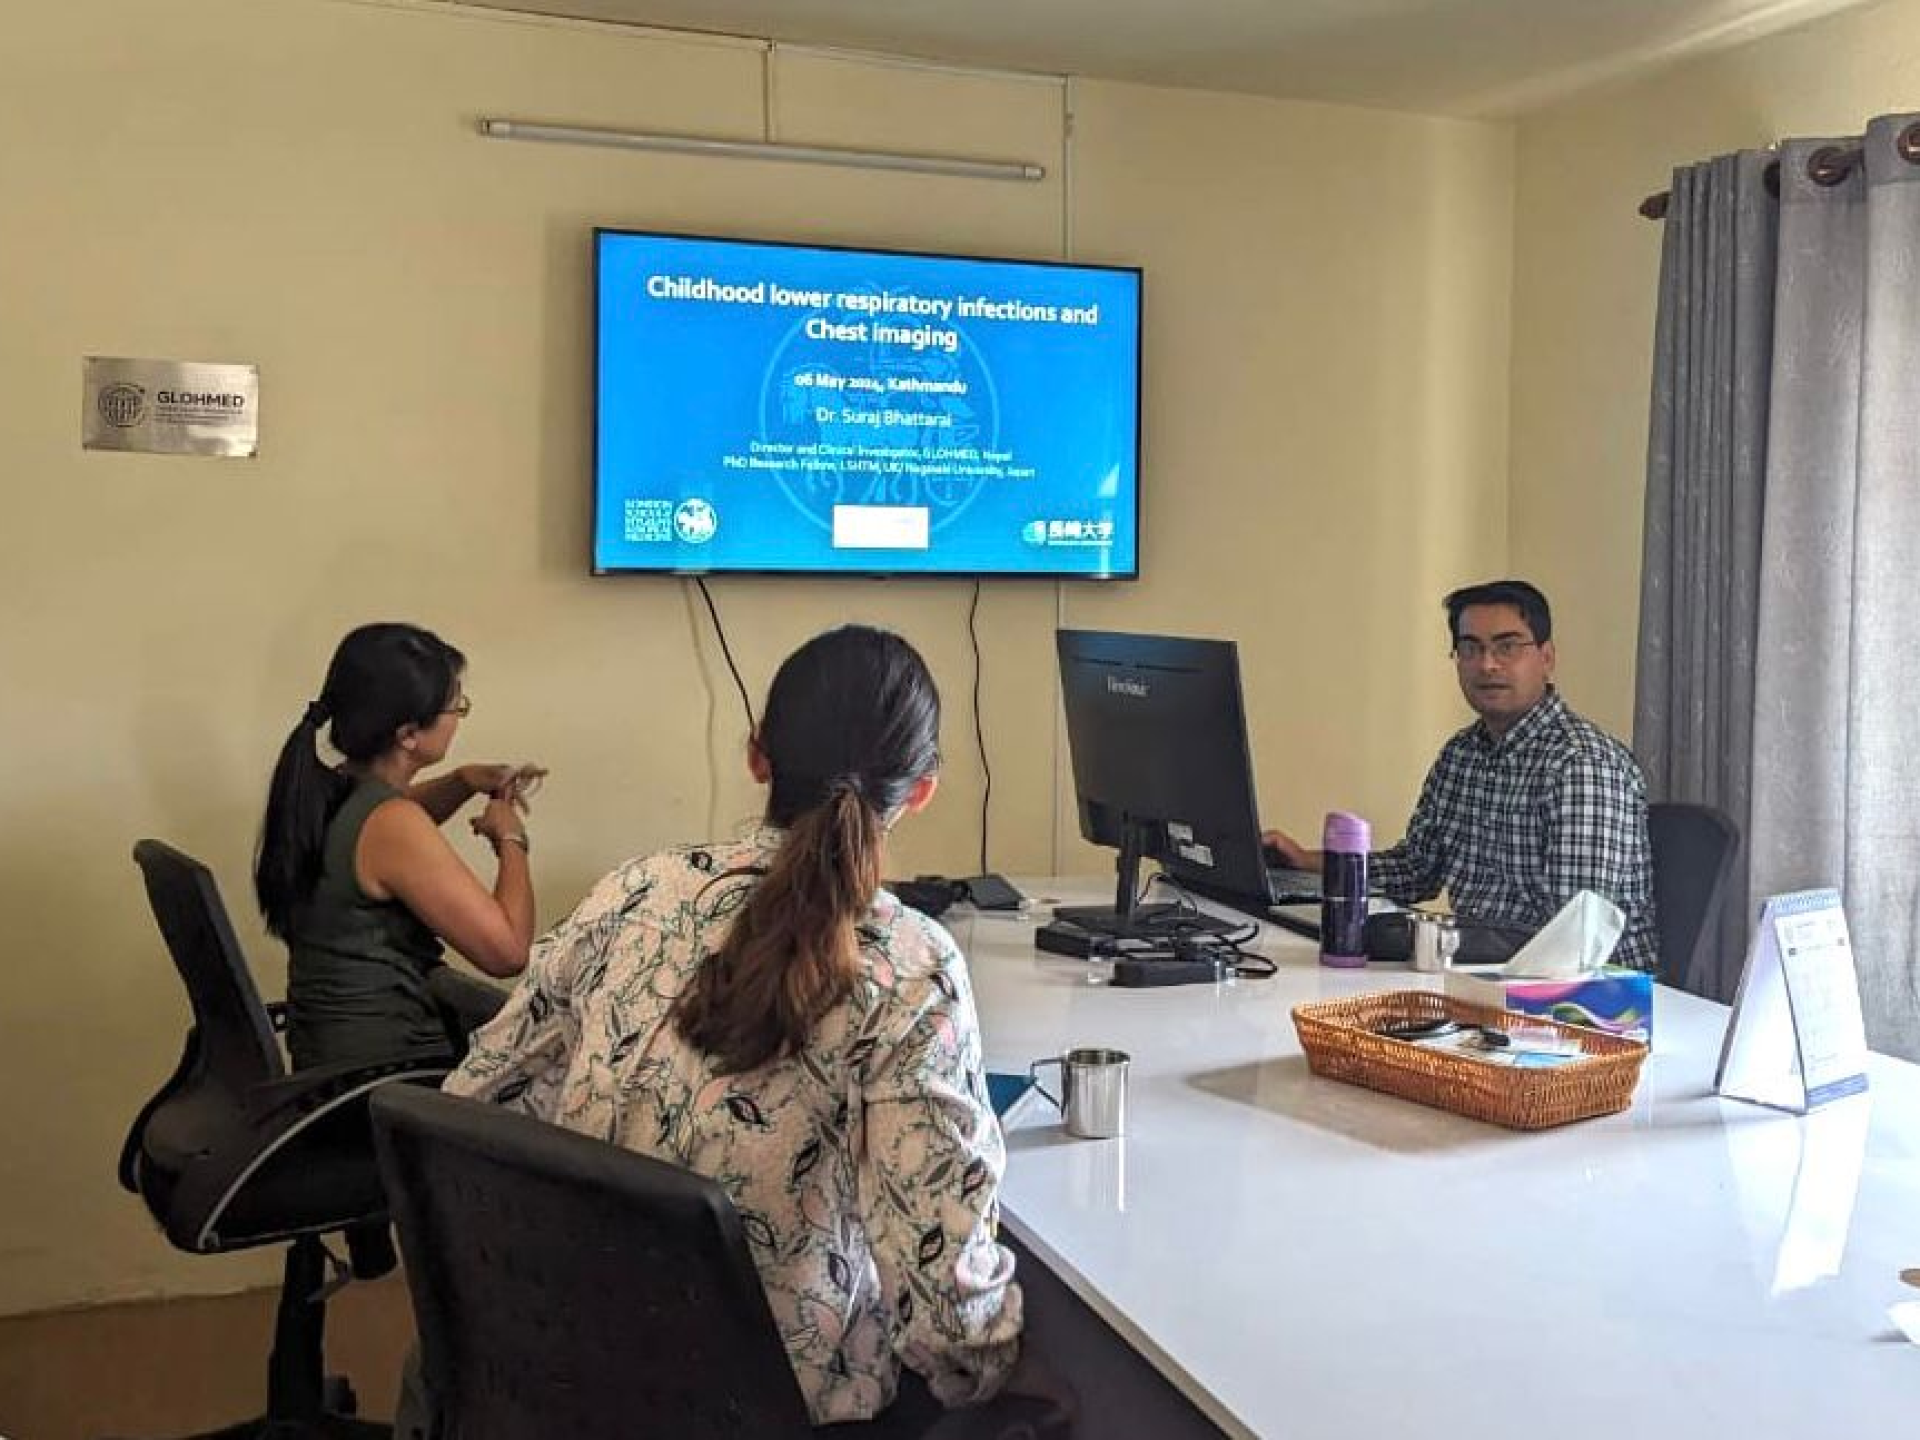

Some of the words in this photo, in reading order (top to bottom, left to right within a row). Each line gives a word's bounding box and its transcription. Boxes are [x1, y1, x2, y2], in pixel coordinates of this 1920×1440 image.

[647, 275, 764, 304] Childhood
[769, 282, 832, 308] lower
[836, 291, 952, 321] respiratory
[958, 295, 1057, 322] infections
[1060, 304, 1098, 326] and
[805, 318, 868, 342] Chest
[872, 322, 958, 352] imaging
[816, 374, 844, 391] May
[887, 377, 968, 394] Kathmandu
[157, 391, 245, 408] GLOHMED
[842, 409, 880, 428] Suraj
[884, 409, 952, 428] Bhattarai
